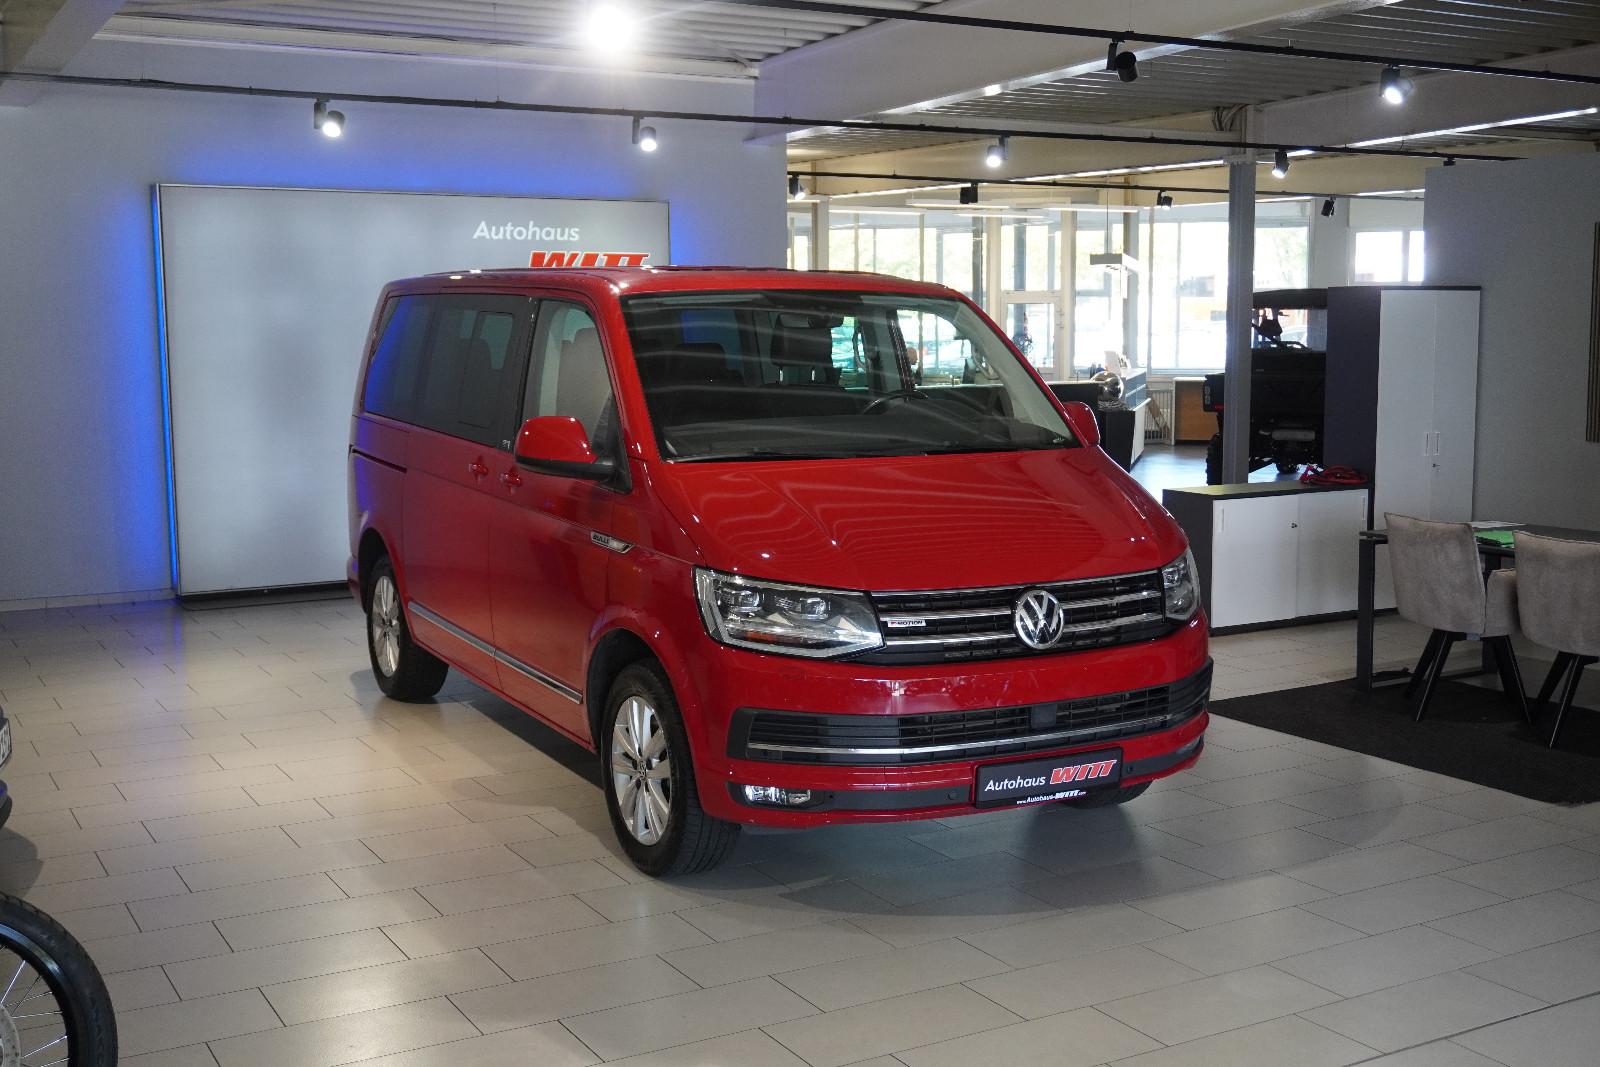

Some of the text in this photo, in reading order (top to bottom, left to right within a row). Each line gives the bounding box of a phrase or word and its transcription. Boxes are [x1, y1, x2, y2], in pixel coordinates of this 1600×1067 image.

[473, 220, 580, 241] Autohaus
[984, 759, 1118, 792] Autohaus WITT
